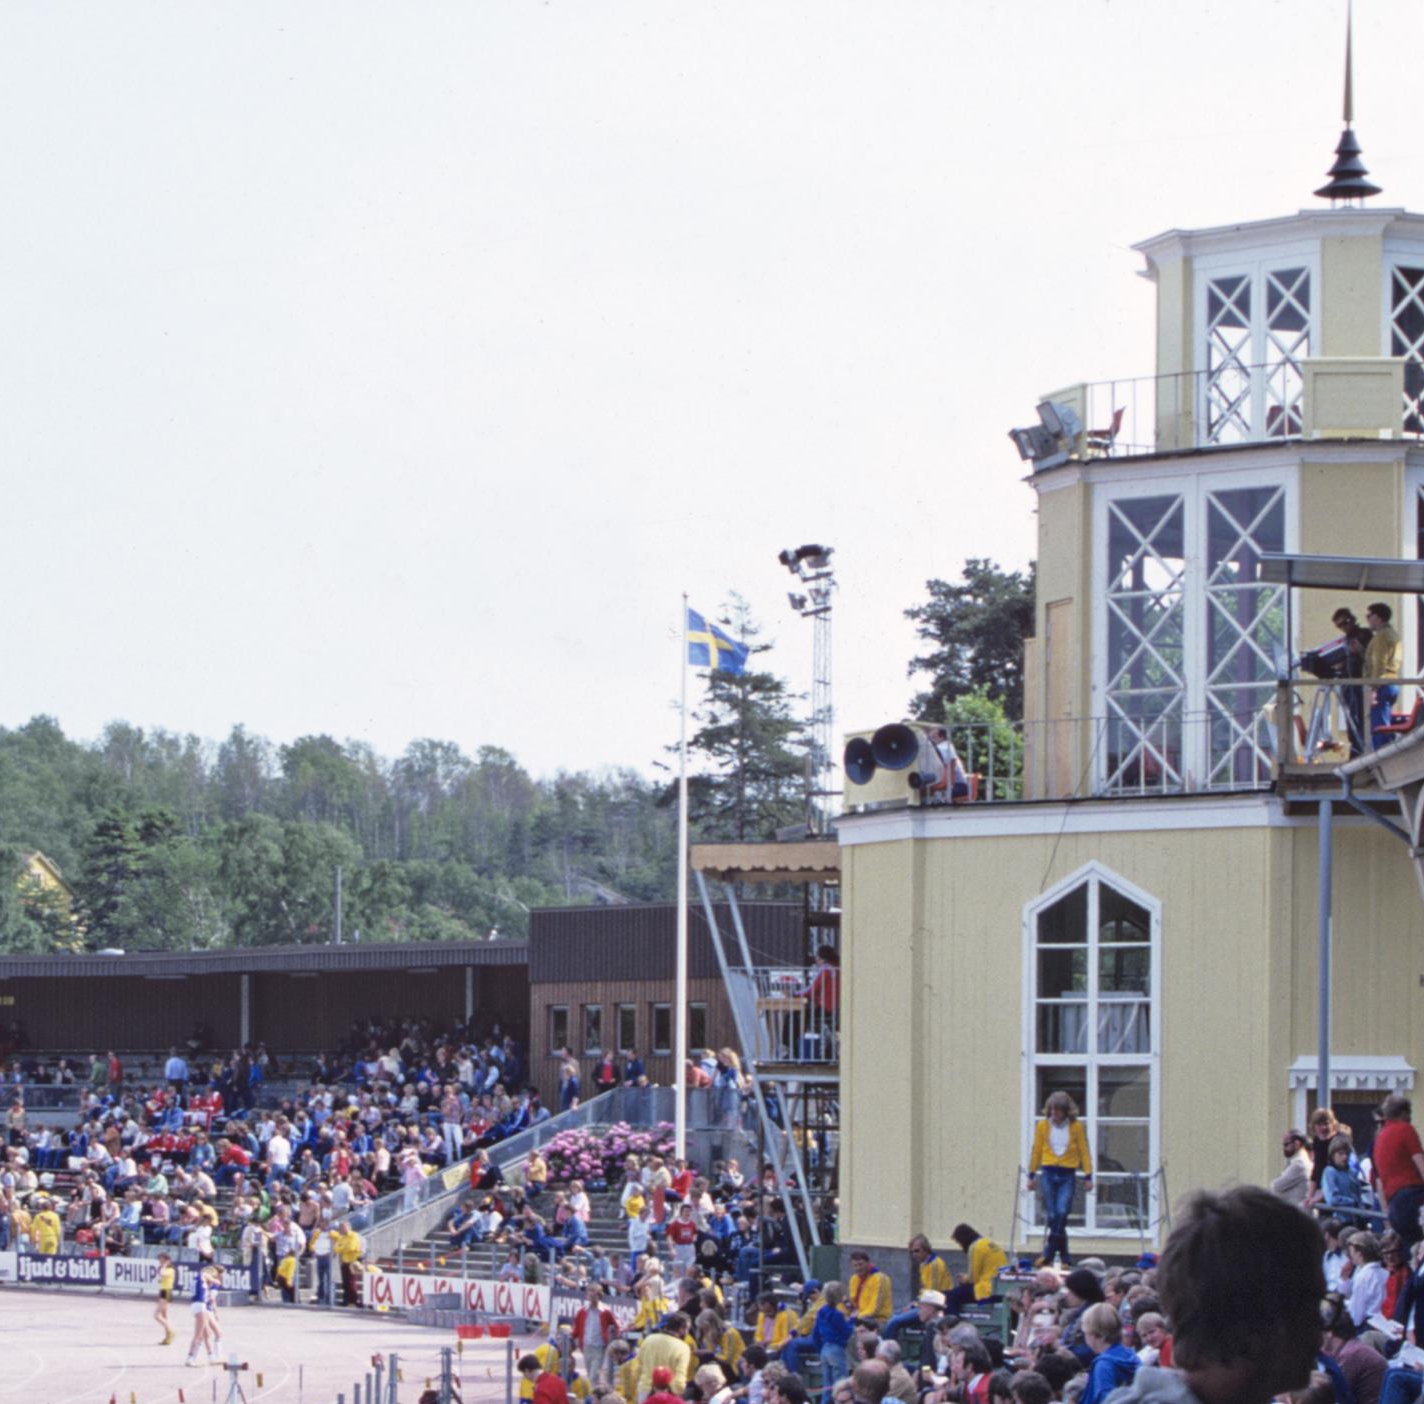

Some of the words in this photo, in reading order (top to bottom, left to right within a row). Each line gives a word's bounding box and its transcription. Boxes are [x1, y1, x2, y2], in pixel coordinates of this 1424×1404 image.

[19, 1256, 53, 1278] ljud
[55, 1258, 67, 1277] &
[69, 1258, 101, 1280] bild
[114, 1262, 162, 1285] PHILIP
[369, 1274, 394, 1305] ICA
[402, 1276, 427, 1307] ICA
[464, 1281, 486, 1312] ICA
[494, 1283, 515, 1316] ICA
[522, 1285, 543, 1319] ICA
